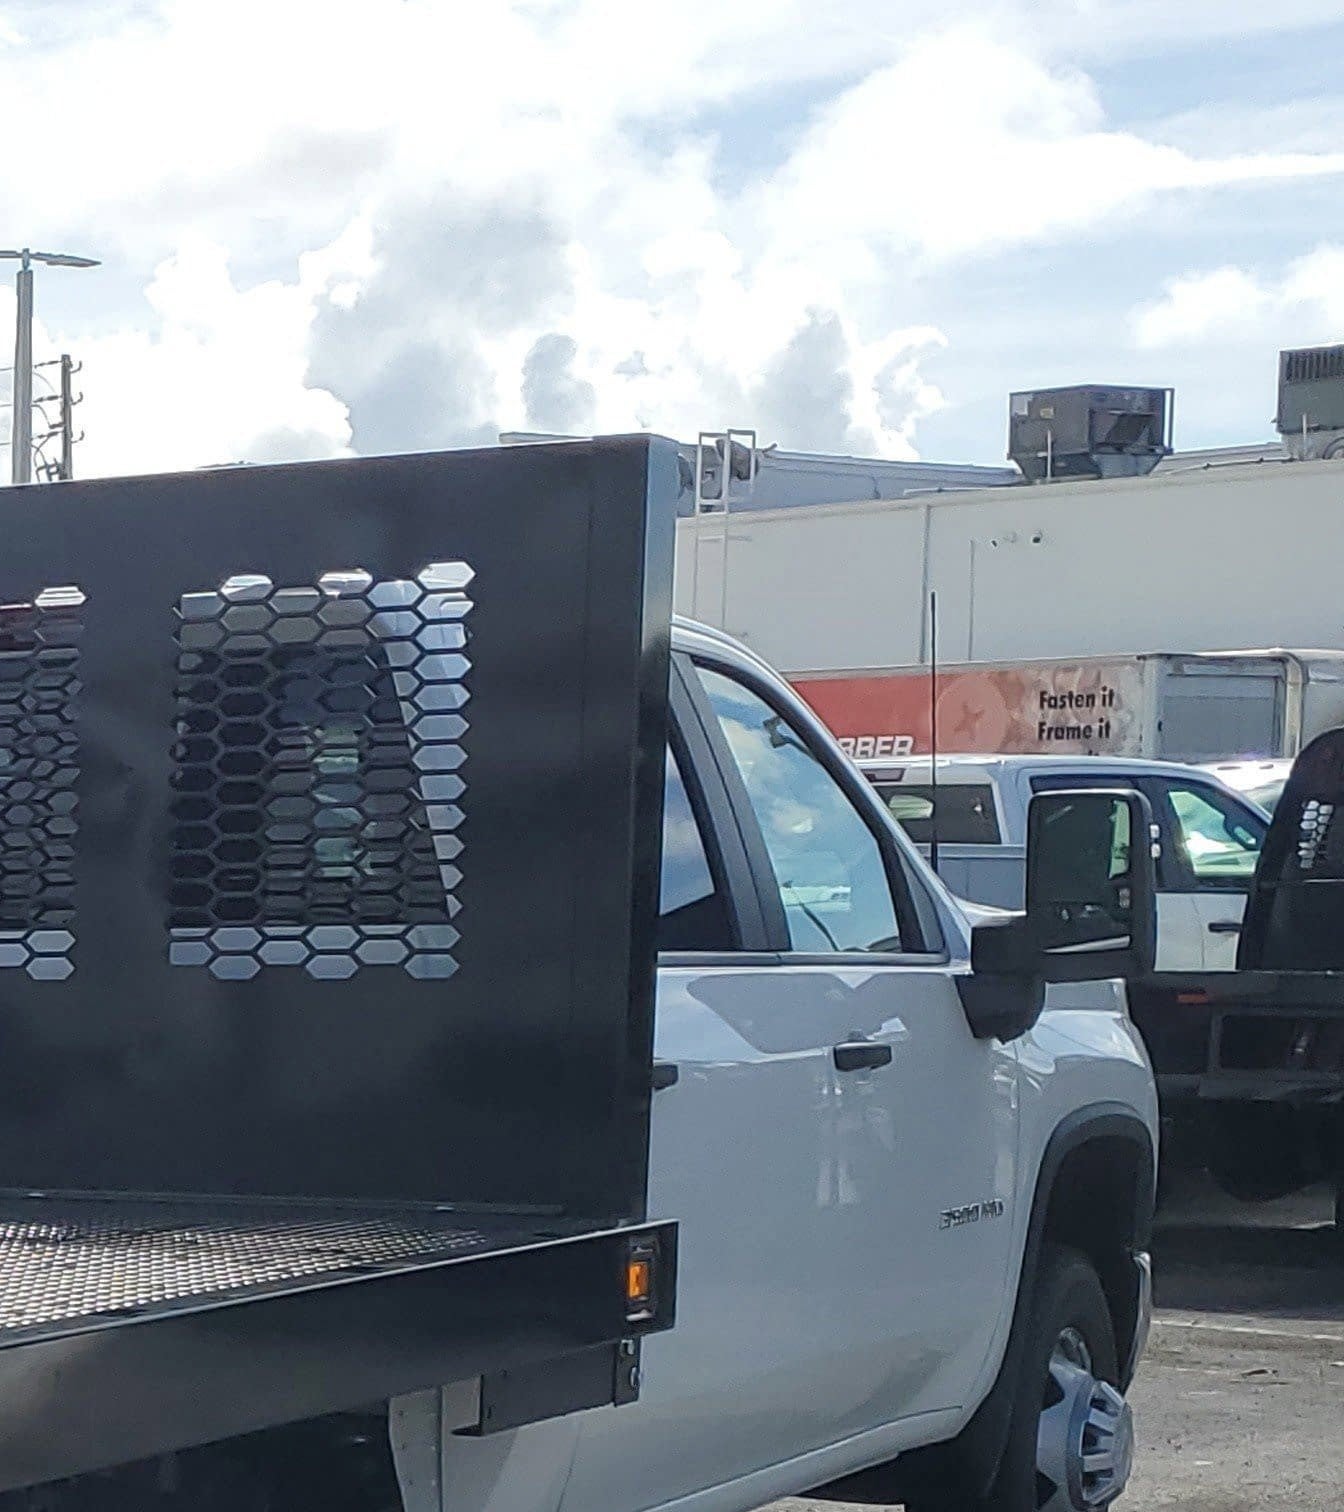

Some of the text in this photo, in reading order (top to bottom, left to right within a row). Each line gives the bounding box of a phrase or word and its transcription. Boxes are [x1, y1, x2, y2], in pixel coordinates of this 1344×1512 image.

[1039, 686, 1115, 711] Fasten it
[1038, 717, 1112, 741] Frame it
